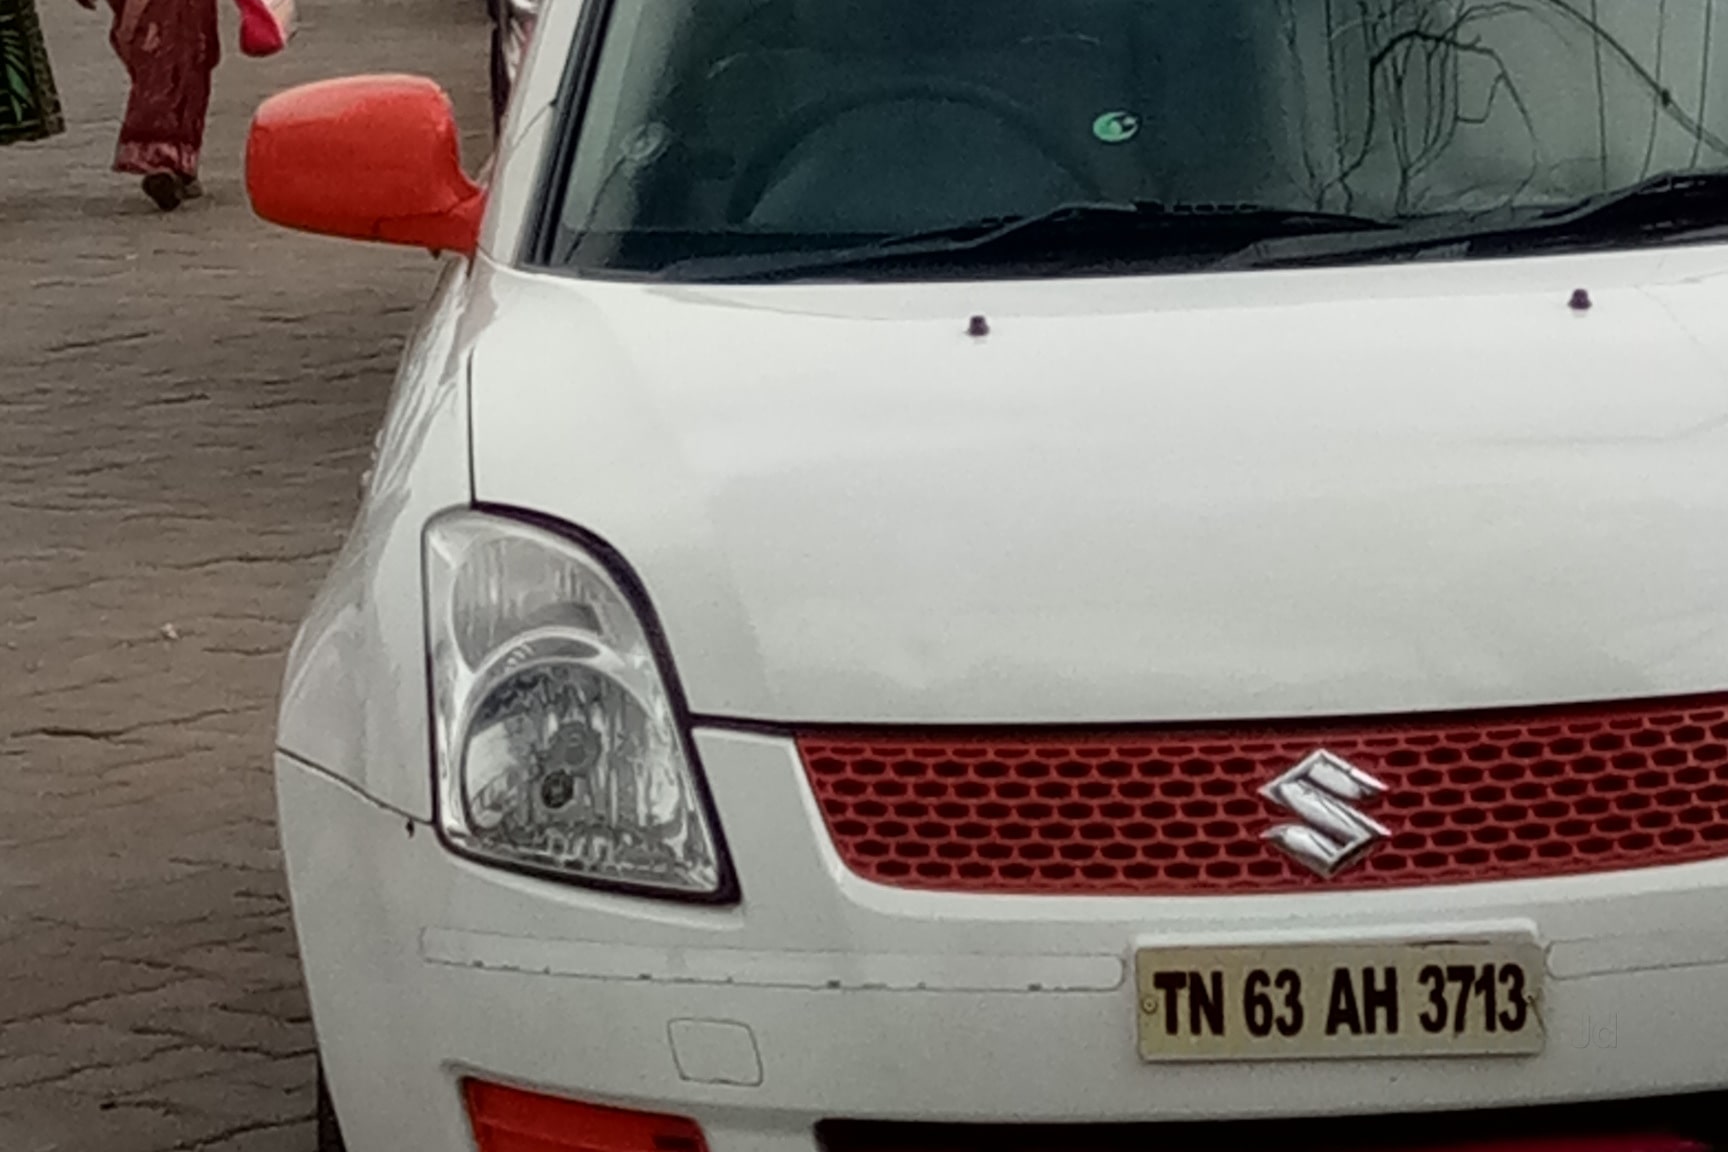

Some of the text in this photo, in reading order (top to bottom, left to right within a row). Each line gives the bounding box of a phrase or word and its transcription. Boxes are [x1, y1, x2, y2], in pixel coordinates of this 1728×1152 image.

[1154, 963, 1527, 1037] TN 63 AH 3713
